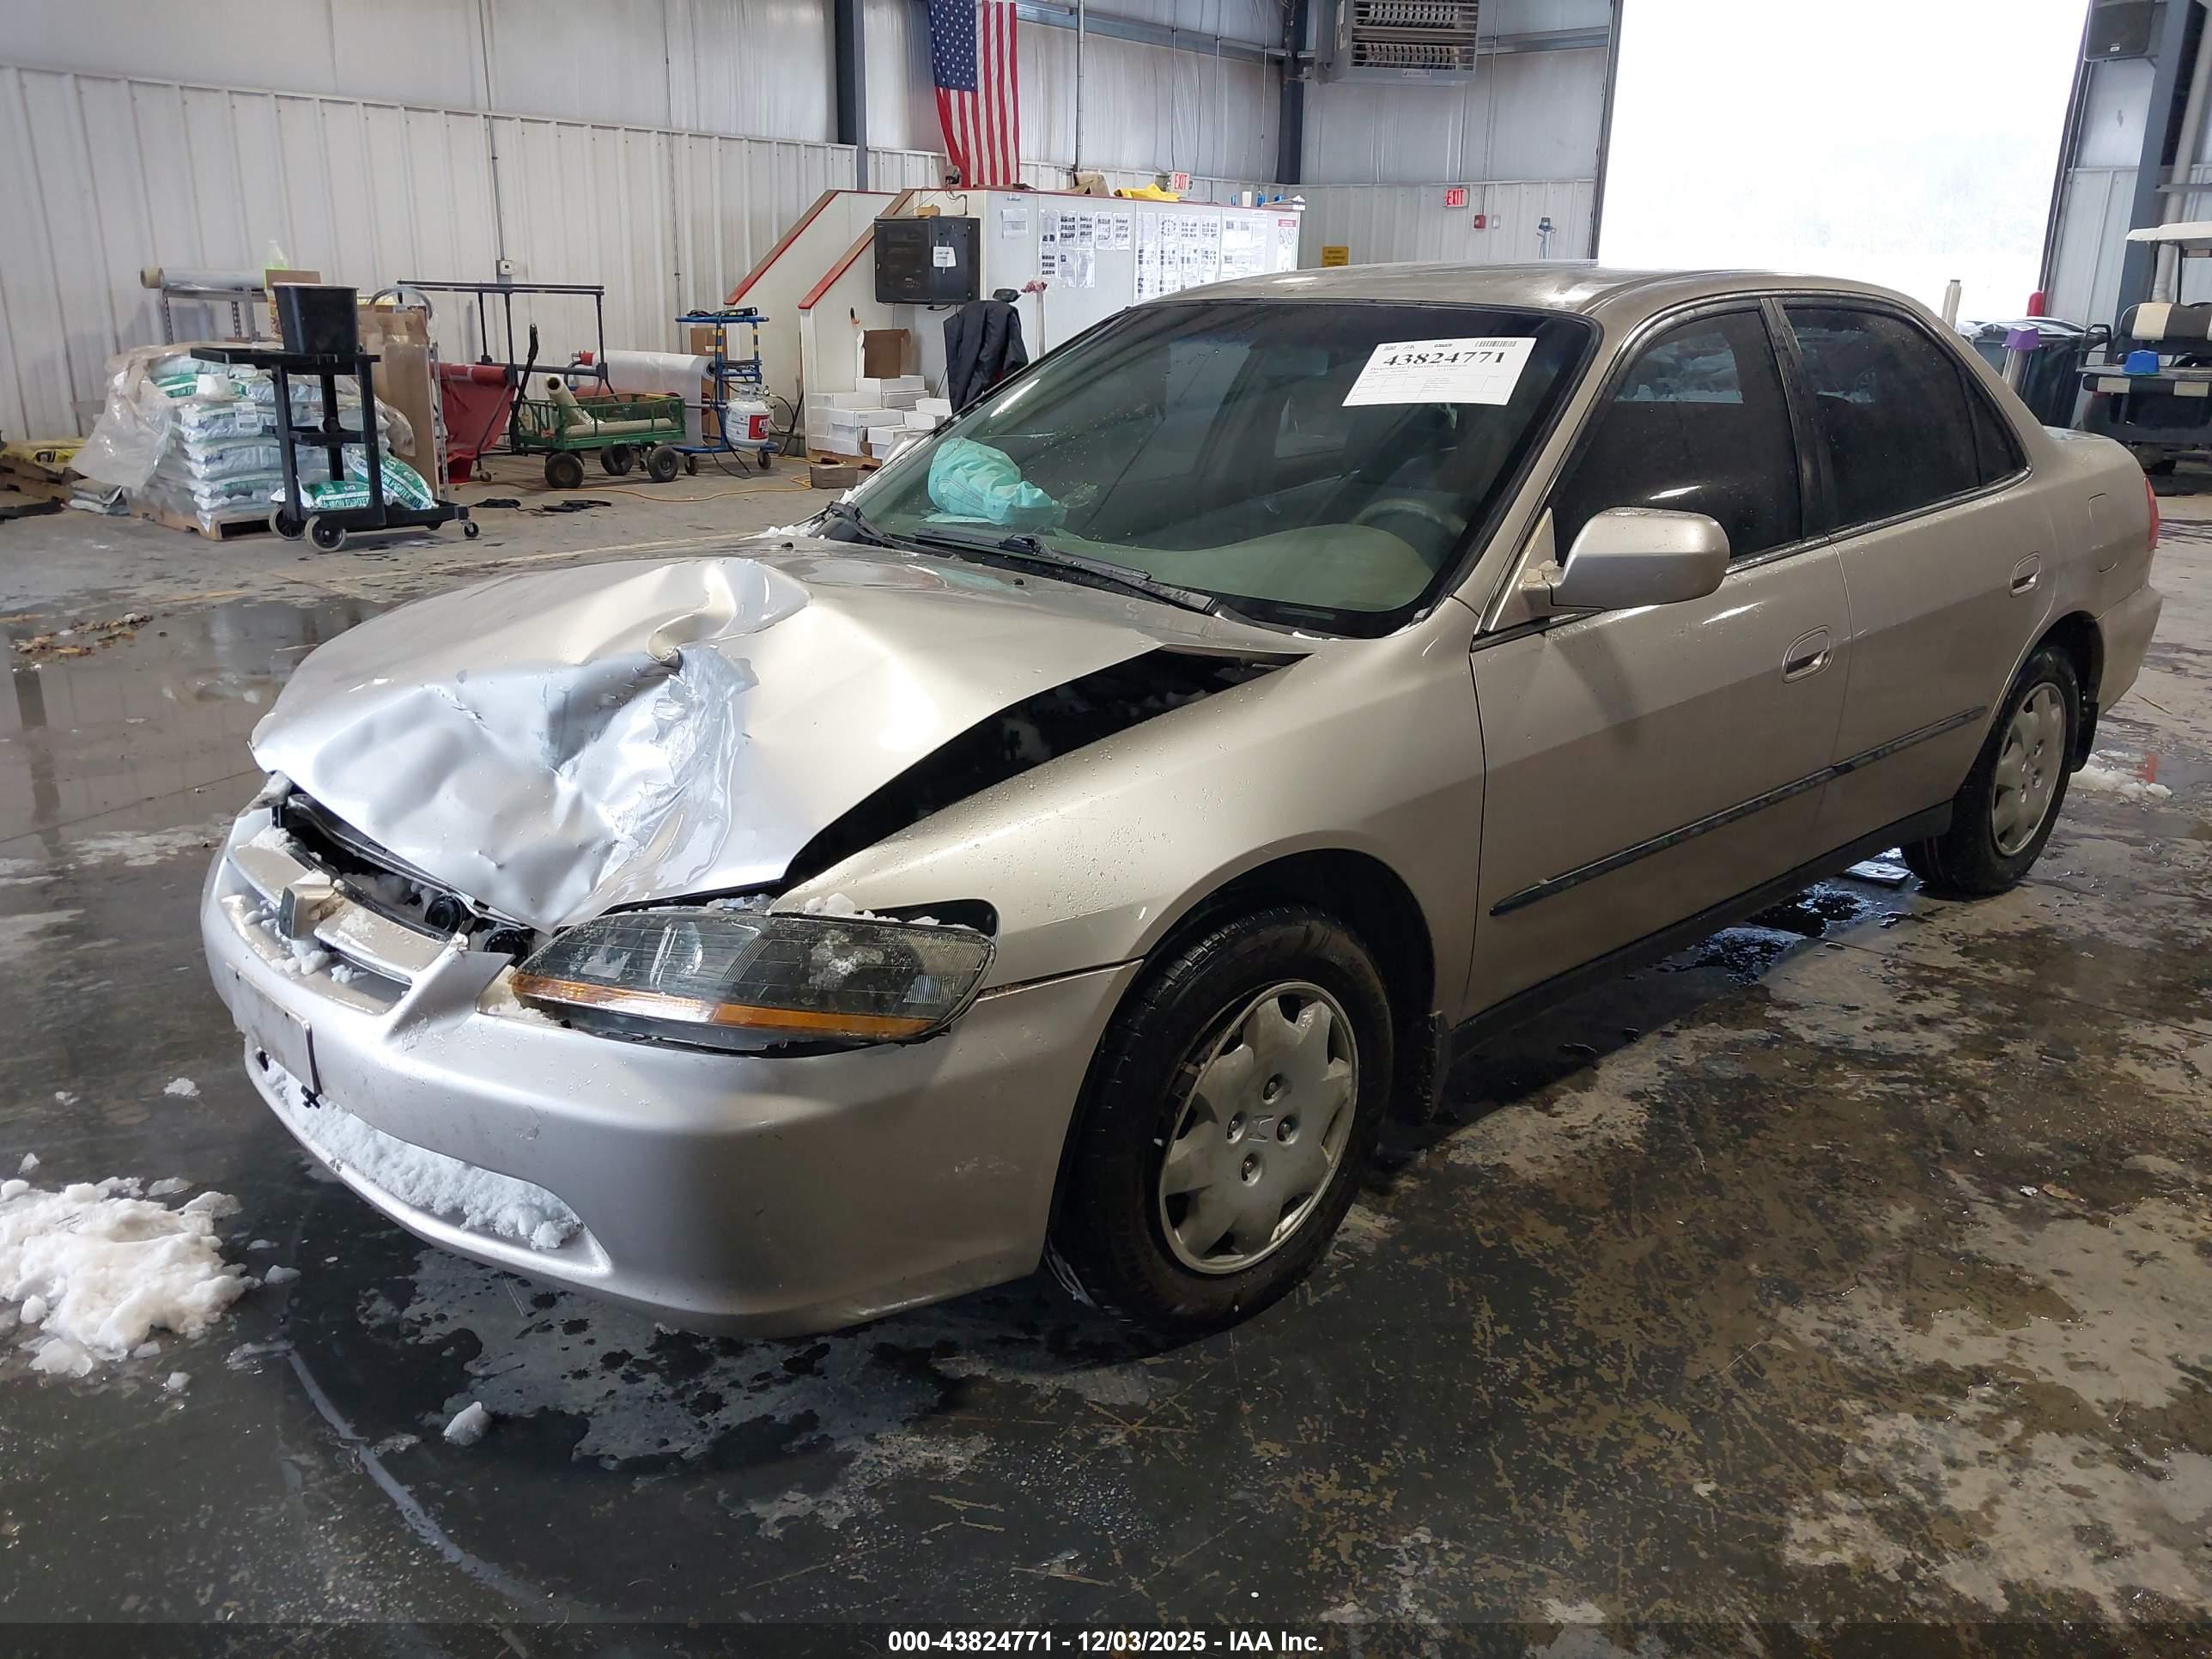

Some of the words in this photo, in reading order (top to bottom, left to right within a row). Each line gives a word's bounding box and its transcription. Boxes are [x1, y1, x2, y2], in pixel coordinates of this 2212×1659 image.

[1175, 173, 1188, 190] EXIT
[1447, 189, 1464, 205] EXIT
[1383, 351, 1505, 367] 43824771
